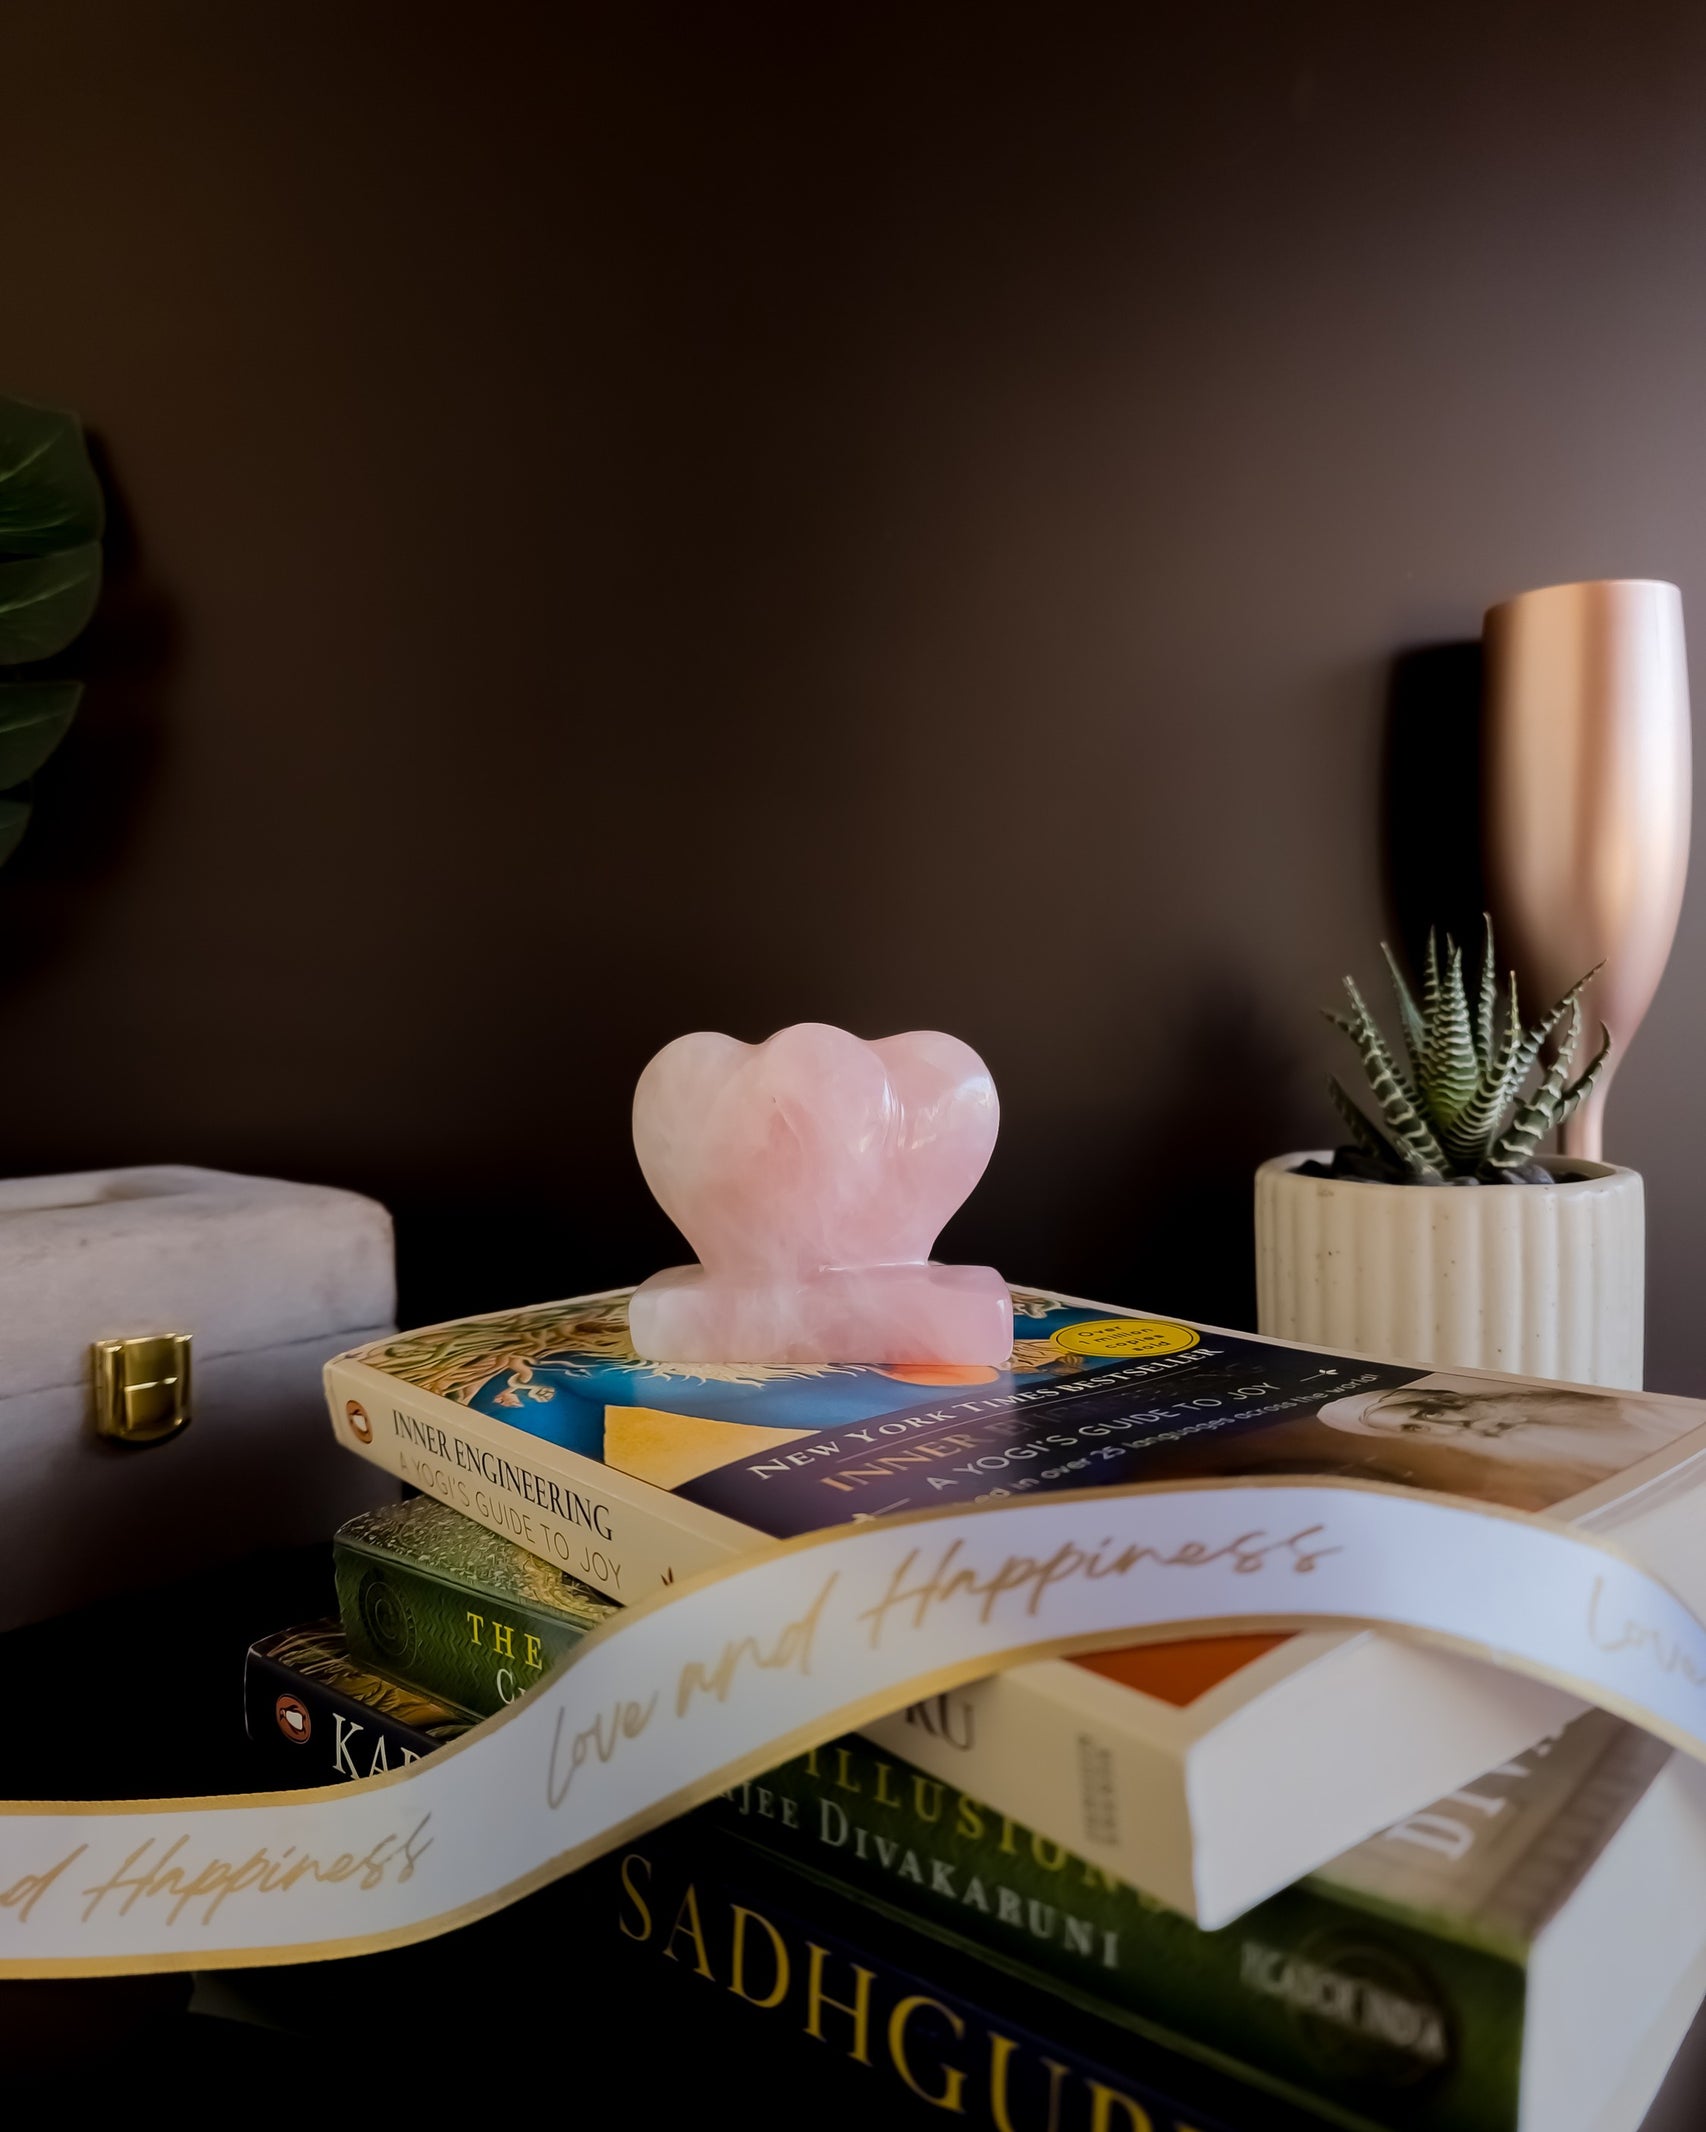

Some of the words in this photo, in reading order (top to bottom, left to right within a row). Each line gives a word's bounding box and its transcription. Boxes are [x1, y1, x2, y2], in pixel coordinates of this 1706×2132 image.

[1078, 1325, 1121, 1337] Over
[1095, 1328, 1154, 1343] million
[1105, 1334, 1164, 1349] copies
[1133, 1341, 1172, 1351] sold
[746, 1440, 840, 1480] NEW
[844, 1409, 957, 1443] YORK
[951, 1387, 1059, 1414] TIMES
[1056, 1348, 1225, 1393] BESTSELLER
[820, 1432, 985, 1493] INNER
[926, 1476, 959, 1491] A
[953, 1434, 1078, 1476] YOGI'S
[1078, 1408, 1182, 1437] GUIDE
[1173, 1397, 1222, 1412] TO
[1227, 1382, 1280, 1401] JOY
[1009, 1477, 1040, 1491] in
[1041, 1456, 1091, 1480] over
[1090, 1446, 1127, 1461] 25
[1121, 1416, 1235, 1450] languages
[1234, 1400, 1298, 1420] across
[1294, 1391, 1328, 1405] the
[391, 1408, 452, 1463] INNER
[453, 1437, 614, 1542] ENGINEERING
[399, 1451, 408, 1470] A
[412, 1457, 470, 1509] YOGI'S
[475, 1490, 537, 1544] GUIDE
[539, 1522, 571, 1561] TO
[579, 1546, 623, 1590] JOY
[466, 1611, 543, 1671] THE
[546, 1690, 661, 1811] Love
[675, 1570, 840, 1722] and
[856, 1521, 1347, 1650] Happiness
[82, 1811, 436, 1928] Happiness
[803, 1745, 1168, 1914] ILLUSIO
[618, 1853, 1205, 2132] SADHGU
